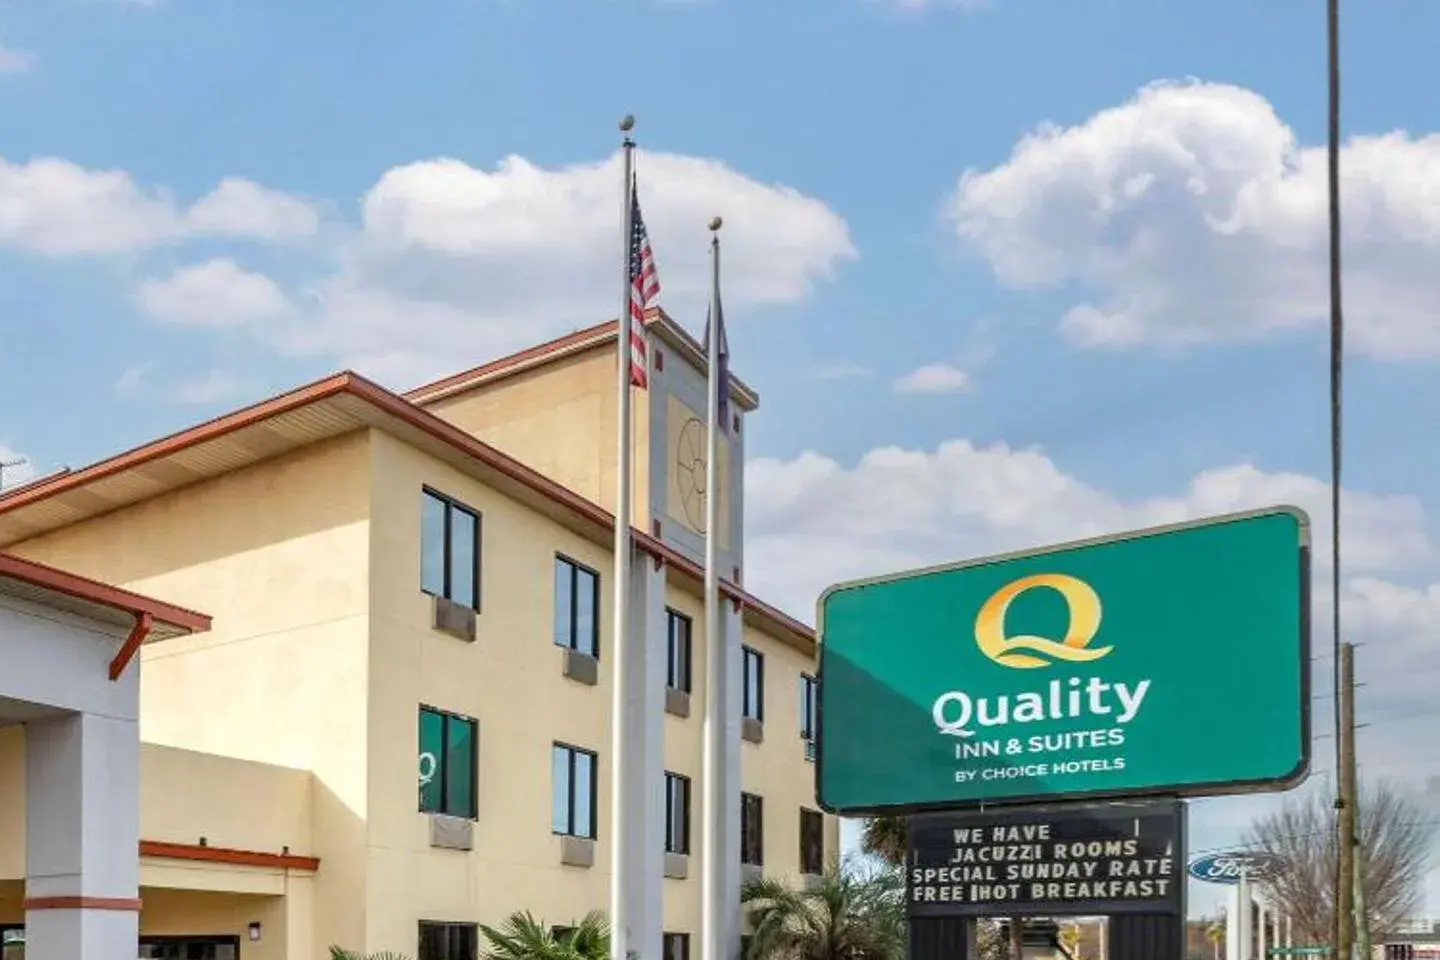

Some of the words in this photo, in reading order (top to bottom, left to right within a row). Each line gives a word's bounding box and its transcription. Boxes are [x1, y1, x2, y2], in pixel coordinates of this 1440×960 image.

[932, 676, 1151, 738] Quality
[955, 740, 1000, 759] INN
[1005, 738, 1023, 755] &
[1028, 728, 1125, 752] SUITES
[955, 769, 977, 782] BY
[982, 763, 1049, 780] CHOICE
[1053, 757, 1126, 774] HOTELS
[953, 828, 983, 844] WE
[993, 825, 1051, 842] HAVE
[952, 844, 1042, 863] JACUZZI
[1054, 840, 1138, 860] ROOMS
[913, 865, 997, 883] SPECIAL
[1007, 862, 1097, 880] SUNDAY
[1110, 859, 1172, 877] RATE
[913, 886, 963, 901] FREE
[1031, 880, 1170, 899] BREAKFAST
